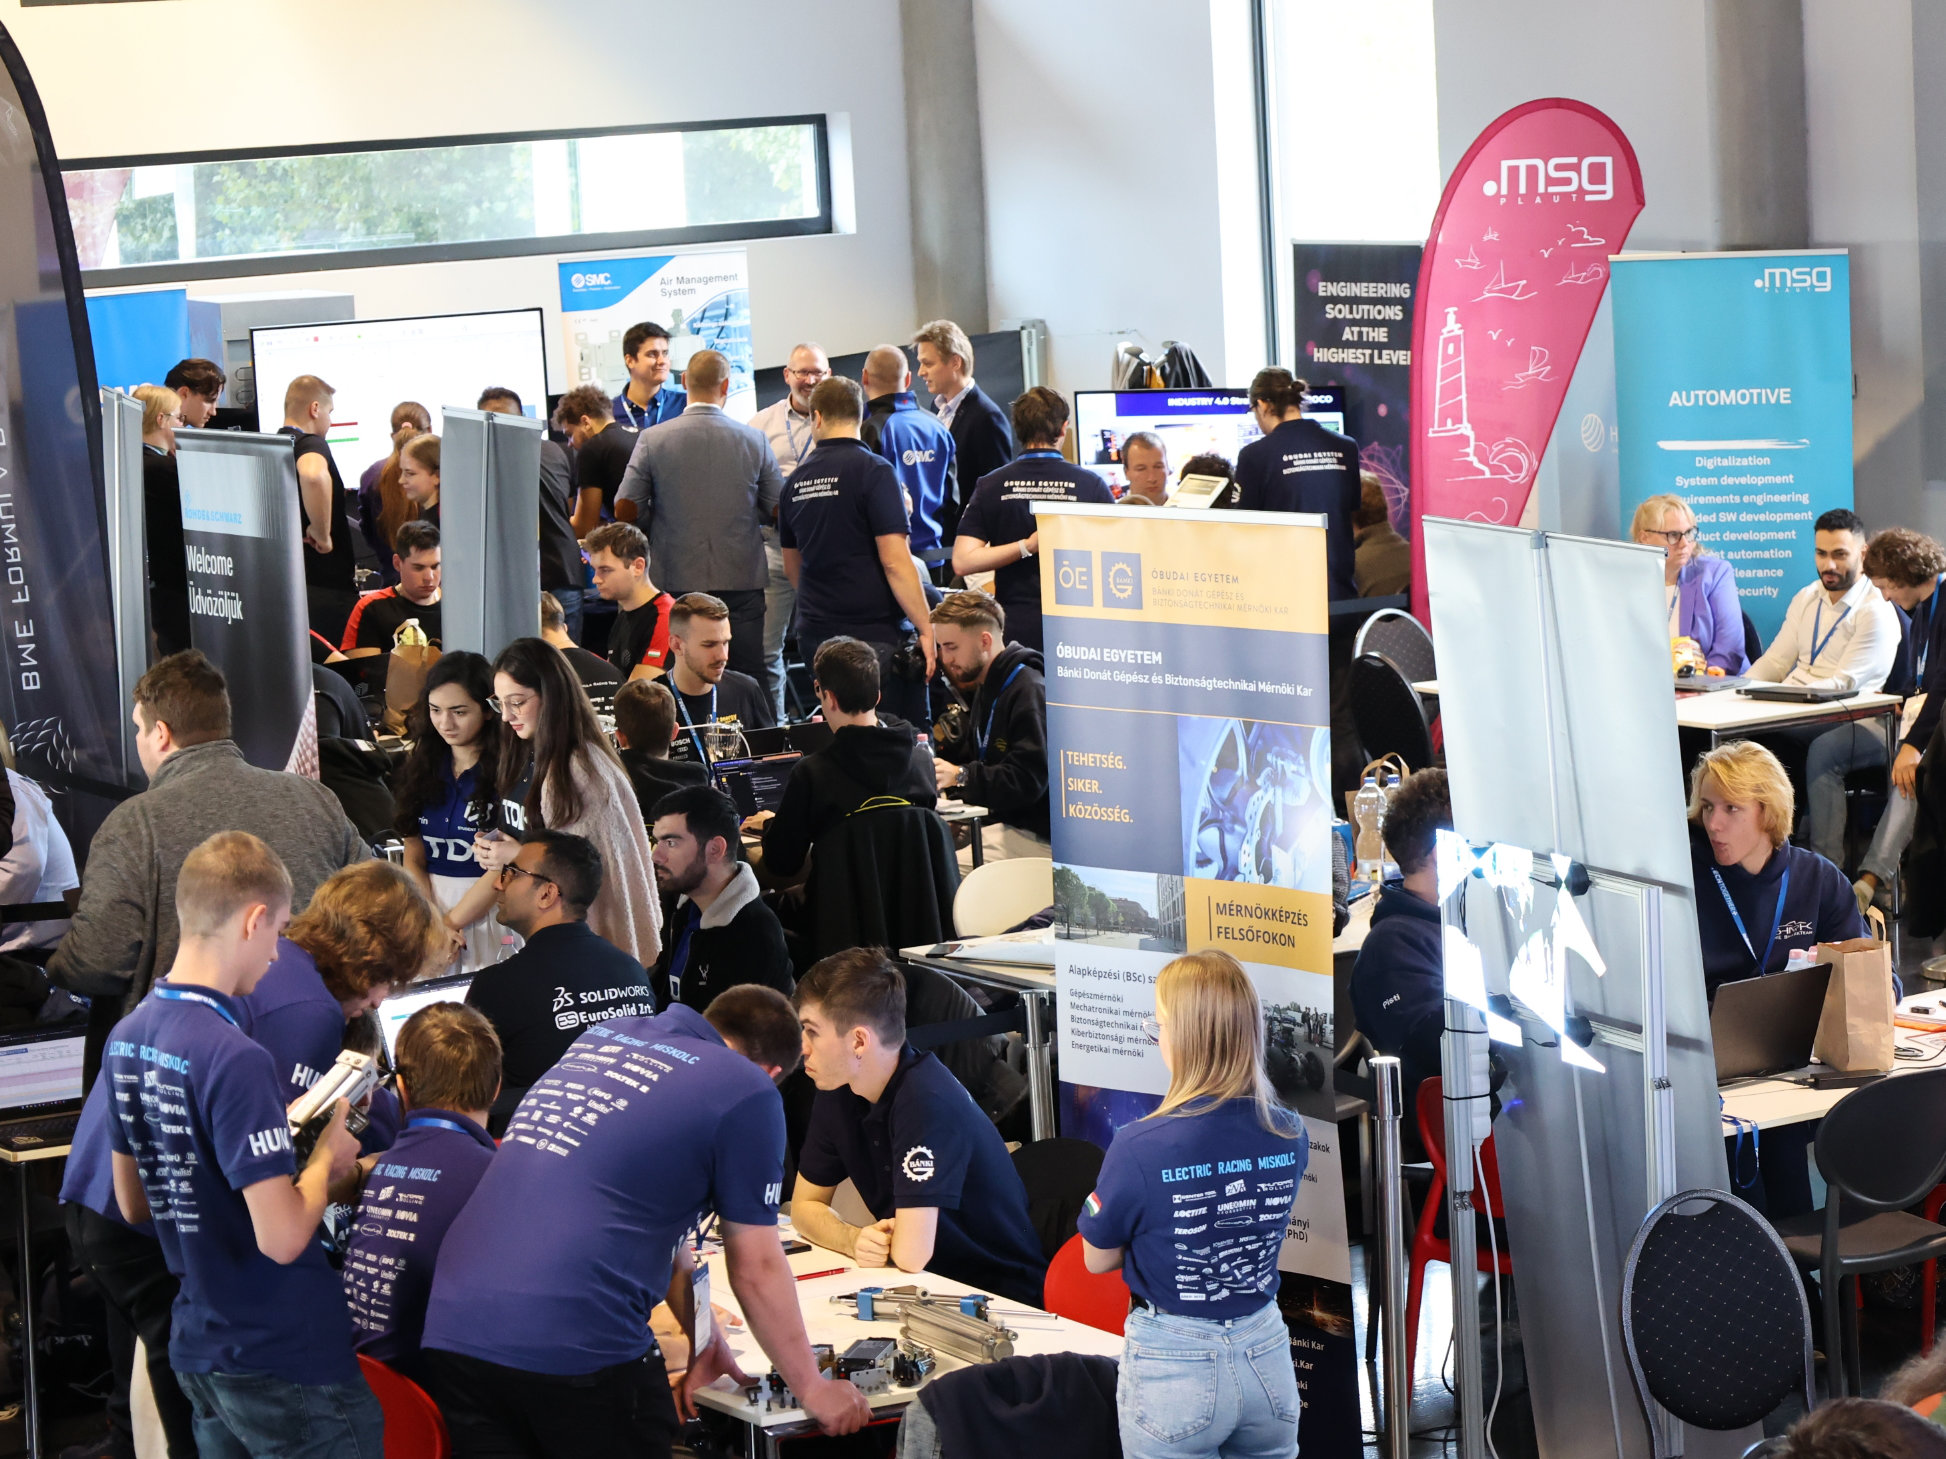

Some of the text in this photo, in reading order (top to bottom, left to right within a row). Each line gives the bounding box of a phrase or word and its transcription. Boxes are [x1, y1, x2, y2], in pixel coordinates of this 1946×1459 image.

[1500, 194, 1577, 206] PLAUT
[585, 272, 612, 287] SMC
[660, 273, 738, 286] Air Management
[661, 287, 696, 298] System
[1318, 281, 1411, 298] ENGINEERING
[1325, 304, 1404, 320] SOLUTIONS
[1342, 327, 1388, 342] AT THE
[1313, 348, 1372, 364] HIGHEST
[1167, 397, 1213, 406] INDUSTRY
[1668, 388, 1792, 407] AUTOMOTIVE
[1695, 456, 1771, 469] Digitalization
[1675, 474, 1794, 488] System development
[1682, 492, 1810, 506] uirements engineering
[1718, 512, 1737, 522] SW
[1739, 511, 1813, 523] development
[1696, 530, 1797, 542] duct development
[186, 545, 234, 577] Welcome
[1727, 548, 1793, 559] automation
[1151, 567, 1240, 584] ÓBUDAI EGYETEM
[1735, 567, 1784, 578] learance
[188, 581, 244, 625] Üdvözöljük
[1057, 642, 1163, 665] ÓBUDAI EGYETEM
[1057, 665, 1313, 697] Bánki Donát Gépész és Biztonságtechnikai Mérnöki Kar
[1067, 750, 1127, 770] TEHETSÉG.
[1068, 777, 1103, 794] SIKER.
[1069, 802, 1134, 824] KÖZÖSSÉG.
[423, 835, 475, 862] TD
[1215, 901, 1309, 928] MÉRNÖKKÉPZÉS
[1217, 924, 1296, 949] FELSŐFOKON
[1069, 964, 1120, 980] Alapképzési
[1122, 971, 1146, 984] (BSc)
[580, 985, 650, 1004] SOLIDWORKS
[1069, 989, 1124, 1003] Gépészmérnöki
[580, 1003, 654, 1023] EuroSolid Zrt.
[1070, 1001, 1120, 1016] Mechatronikai
[1070, 1014, 1138, 1031] Biztonságtechnikai
[1071, 1028, 1125, 1044] Kiberbiztonsági
[649, 1043, 700, 1064] MISKOLC
[1071, 1041, 1144, 1058] Energetikai mérnöki
[291, 1063, 323, 1090] HU
[248, 1127, 290, 1156] HUN
[1309, 1141, 1330, 1153] zakok
[910, 1159, 934, 1168] BÁNKI
[1162, 1152, 1296, 1183] ELECTRIC RACING MISKOLC
[764, 1183, 782, 1205] HU
[1265, 1195, 1292, 1206] NOVIA
[1173, 1207, 1208, 1218] LOCTITE
[1174, 1224, 1208, 1235] TEROSON
[1311, 1341, 1325, 1351] Kar
